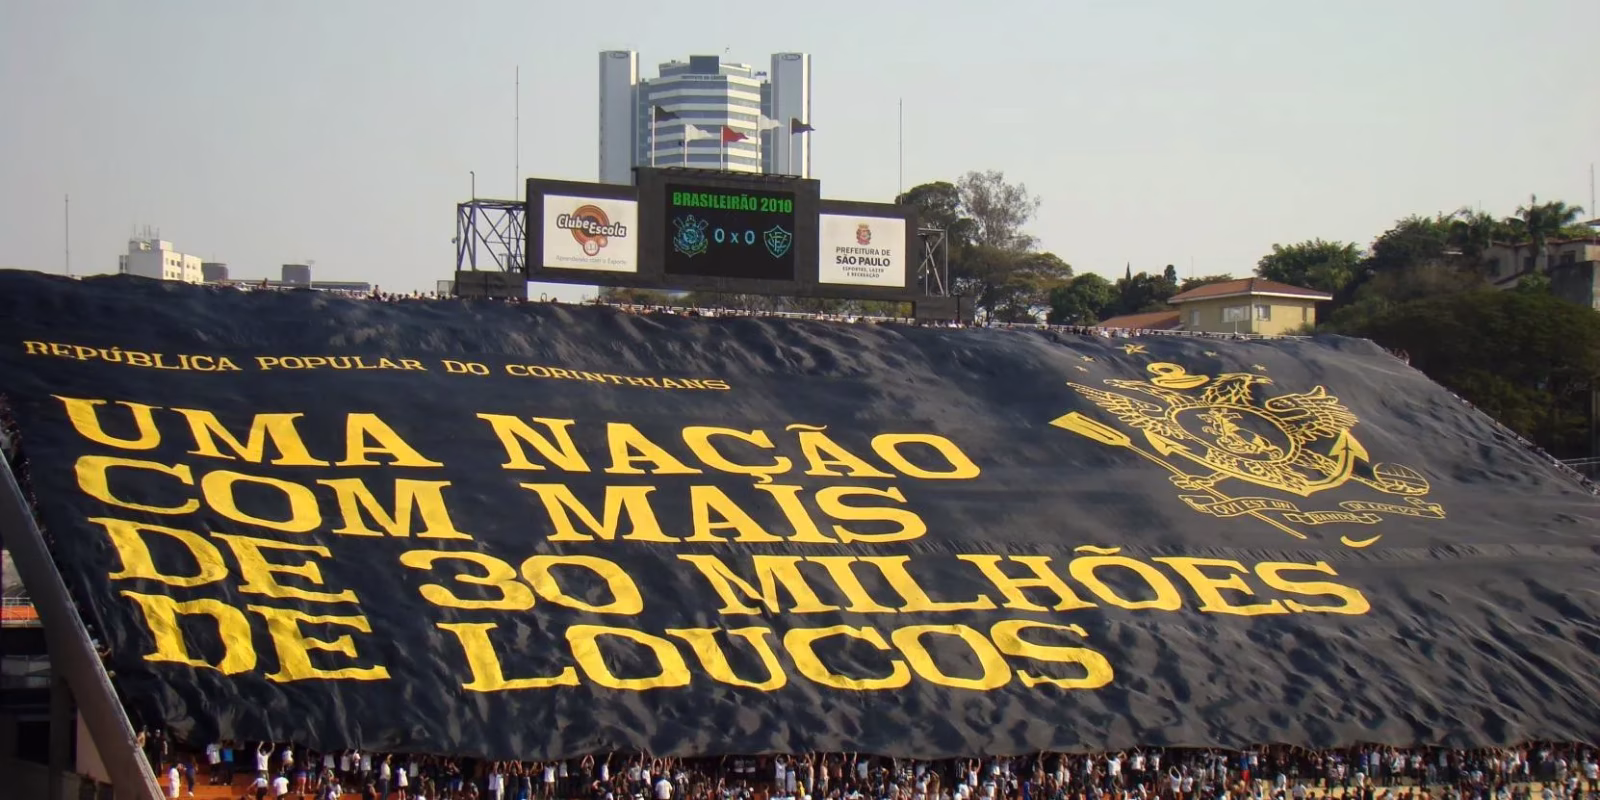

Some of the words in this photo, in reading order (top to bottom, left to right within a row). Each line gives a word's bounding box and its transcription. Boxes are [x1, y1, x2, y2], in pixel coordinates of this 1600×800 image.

[673, 192, 757, 211] BRASILEIRÃO
[760, 197, 793, 213] 2010
[714, 228, 725, 243] 0
[744, 230, 755, 245] 0
[836, 246, 879, 256] PREFEITURA
[836, 253, 857, 265] SÃO
[858, 256, 891, 267] PAULO
[23, 340, 243, 371] REPÚBLICA
[255, 356, 428, 371] POPULAR
[440, 360, 490, 375] DO
[505, 364, 731, 390] CORINTHIANS
[50, 394, 444, 468] UMA
[476, 412, 981, 484] NAÇÃO
[75, 455, 473, 541] COM
[520, 483, 927, 544] MAIS
[1241, 500, 1267, 508] EST
[88, 517, 360, 604] DE
[400, 549, 645, 616] 30
[677, 545, 1371, 616] MILHÕES
[120, 590, 390, 684] DE
[436, 619, 1115, 692] LOUCOS
